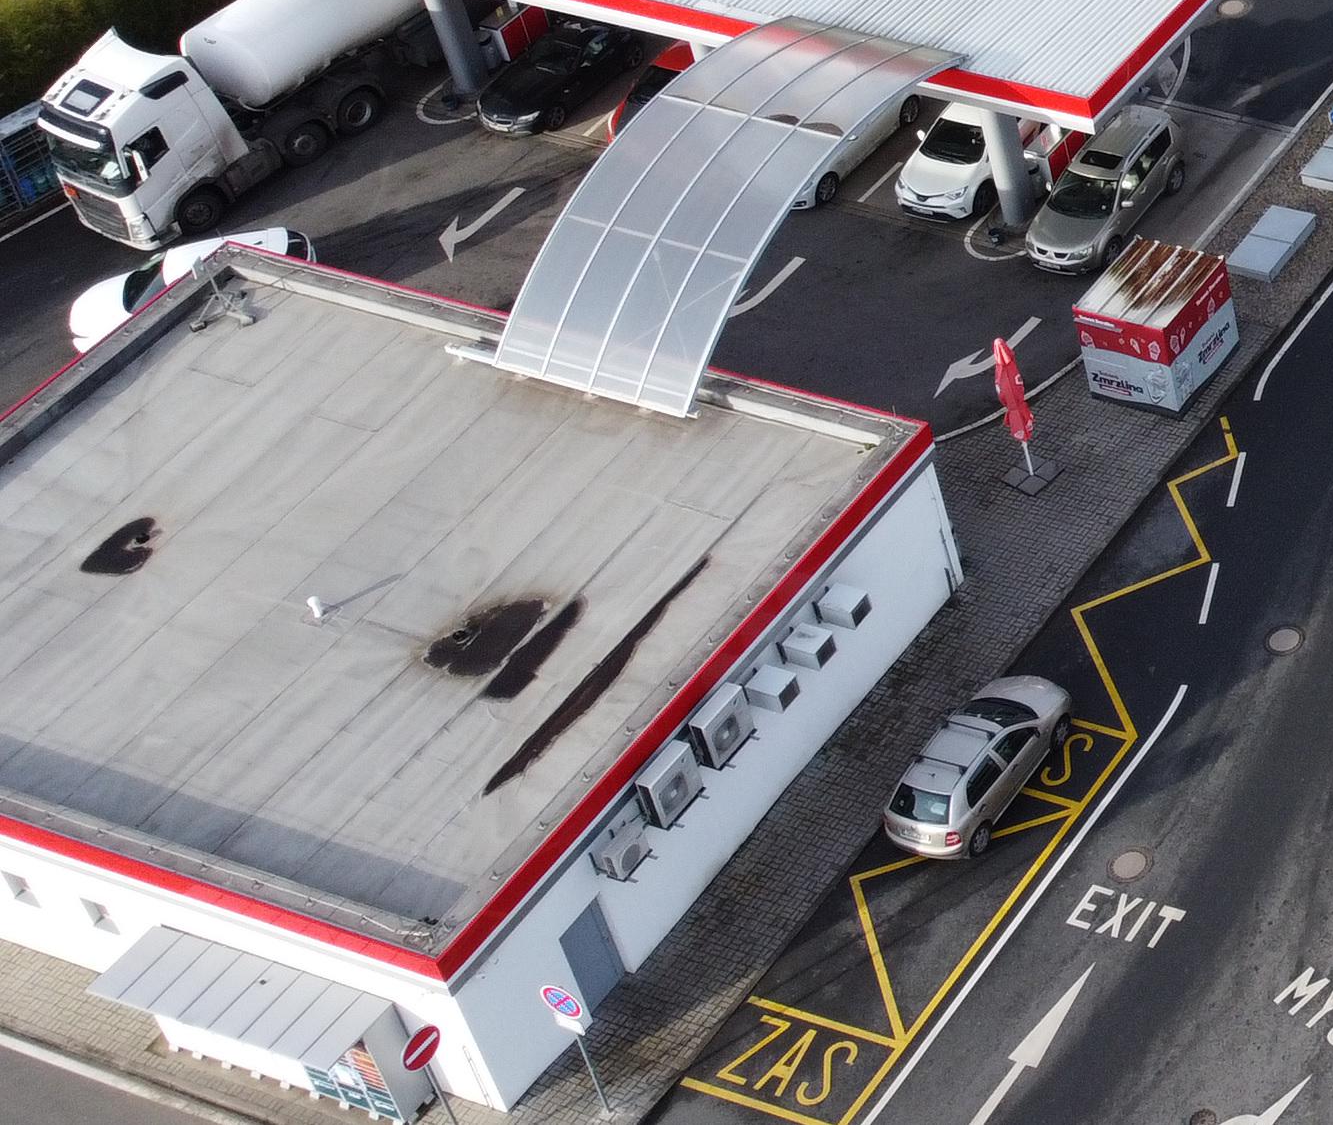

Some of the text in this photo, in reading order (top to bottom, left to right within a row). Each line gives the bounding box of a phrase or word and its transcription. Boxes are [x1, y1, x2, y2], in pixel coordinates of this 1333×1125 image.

[1198, 321, 1230, 363] Zmrzlina
[1091, 371, 1144, 395] Zmrzlina
[1066, 884, 1187, 949] EXIT
[716, 1014, 859, 1107] ZAS
